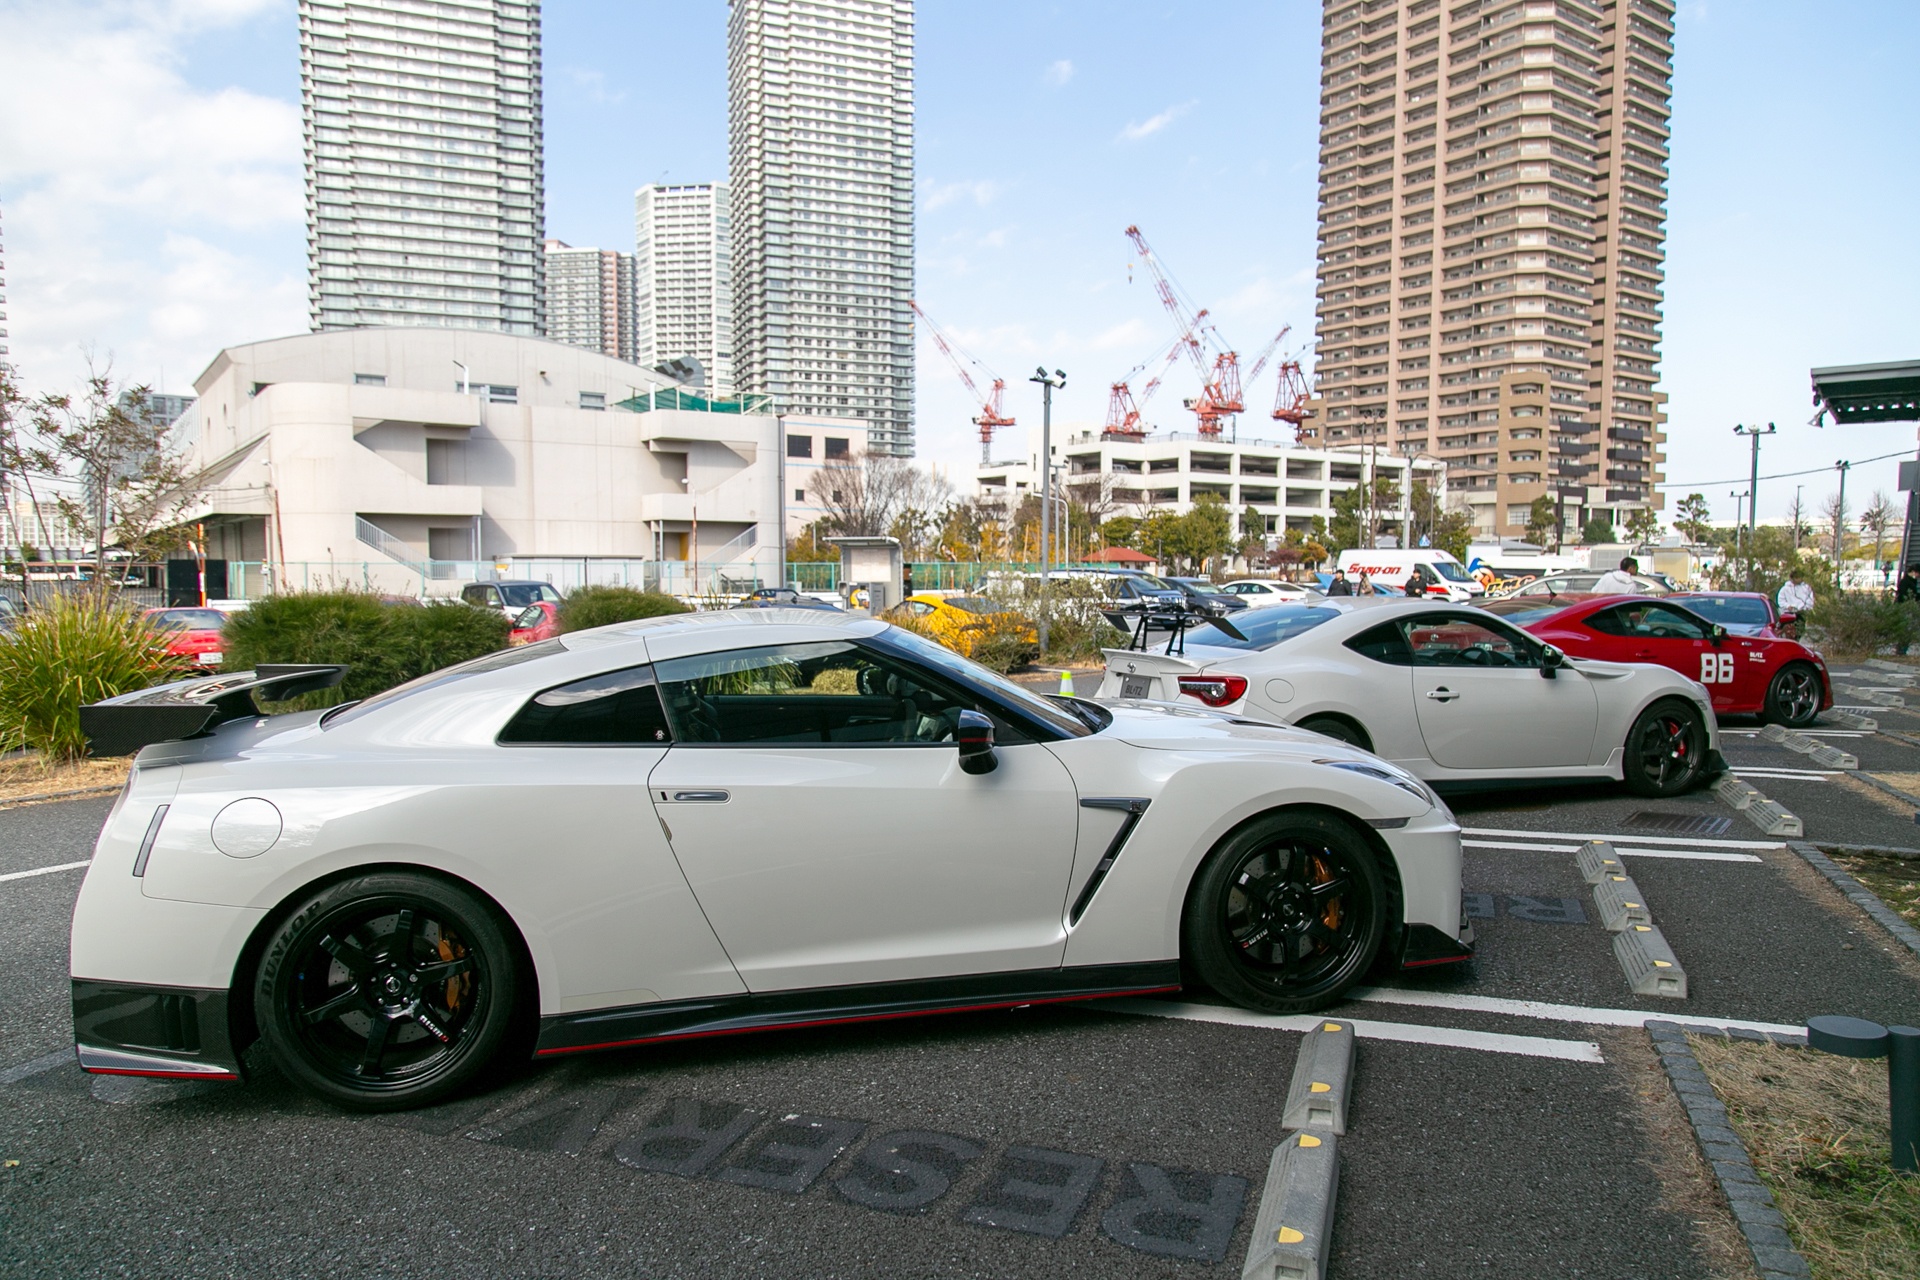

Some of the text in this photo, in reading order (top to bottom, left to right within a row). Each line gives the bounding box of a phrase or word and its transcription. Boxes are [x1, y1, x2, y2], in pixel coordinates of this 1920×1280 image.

[1347, 563, 1401, 577] Snap-on
[1700, 653, 1734, 683] 86
[261, 900, 321, 998] DUNLOP
[419, 1014, 450, 1043] nismo
